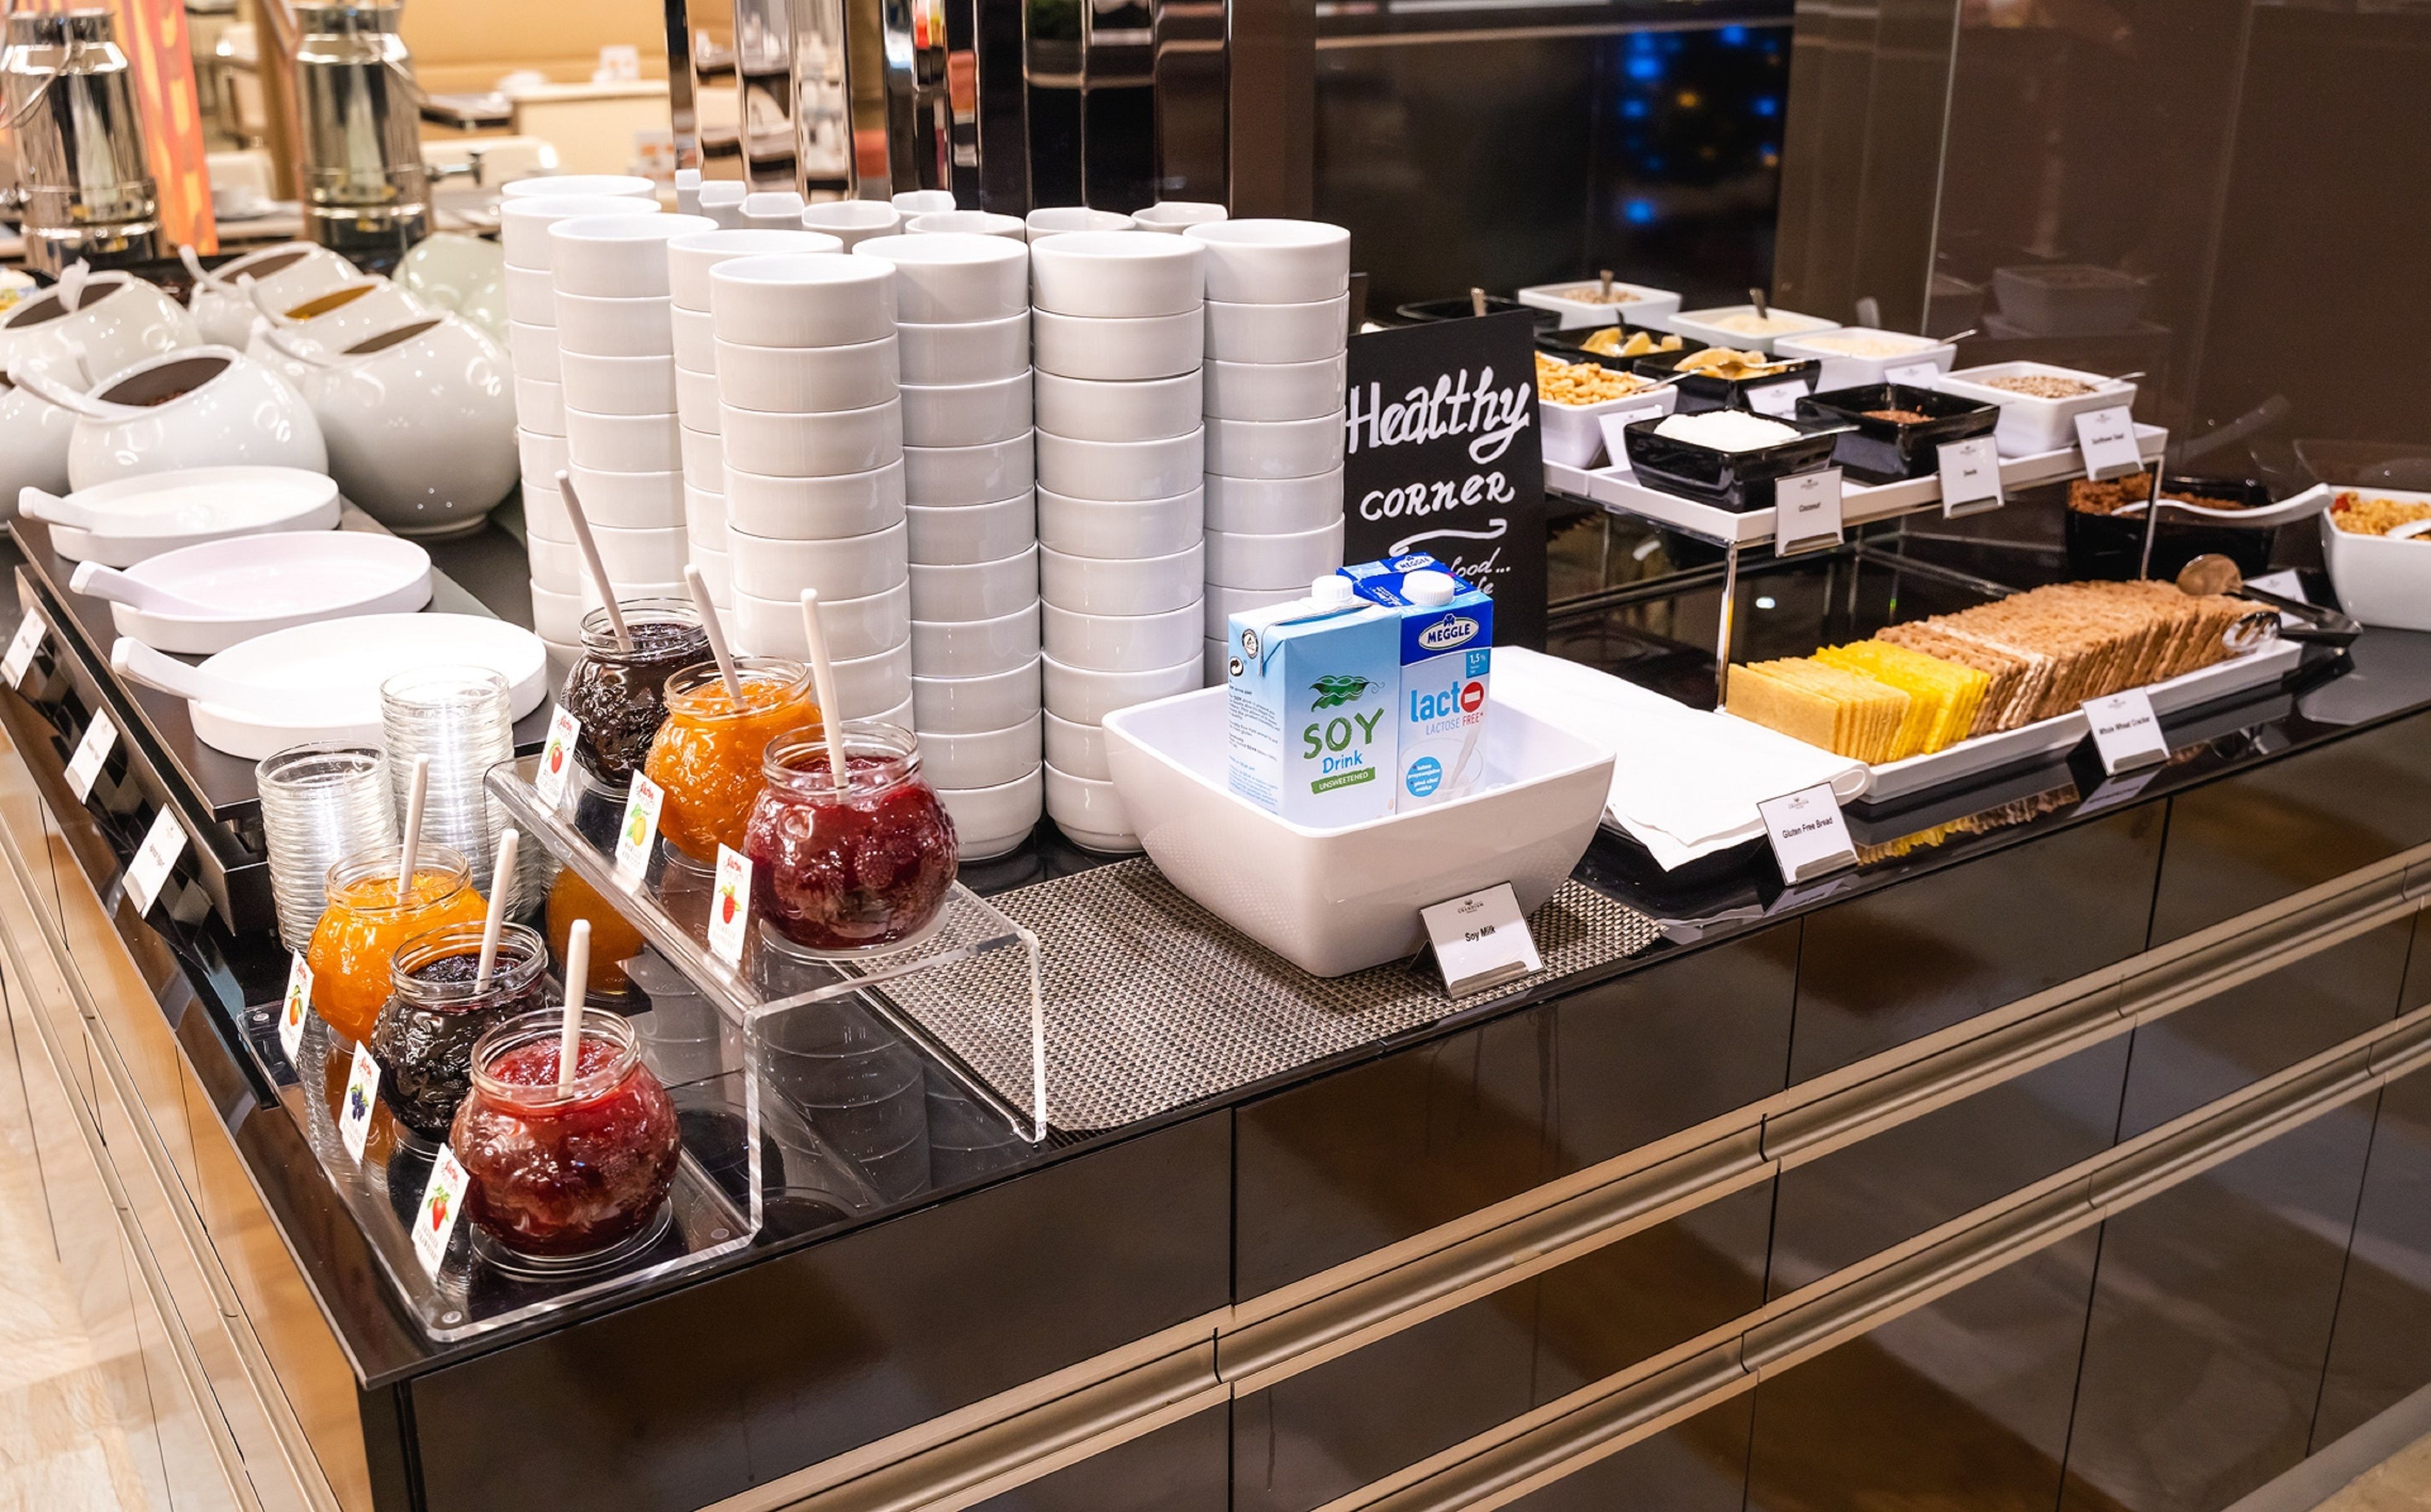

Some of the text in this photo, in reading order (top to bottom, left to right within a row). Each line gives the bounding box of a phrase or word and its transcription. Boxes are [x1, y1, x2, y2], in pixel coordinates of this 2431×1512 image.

[1345, 366, 1531, 464] Healthy
[1428, 623, 1471, 644] MEGGLE
[1470, 653, 1479, 664] 1,5
[1303, 708, 1385, 759] SOY
[1426, 718, 1460, 735] LACTOSE
[1322, 750, 1363, 774] Drink
[1319, 772, 1368, 790] UNSWEETENED
[1782, 816, 1833, 838] Gluten Free Bread
[1465, 925, 1496, 942] Soy Milk
